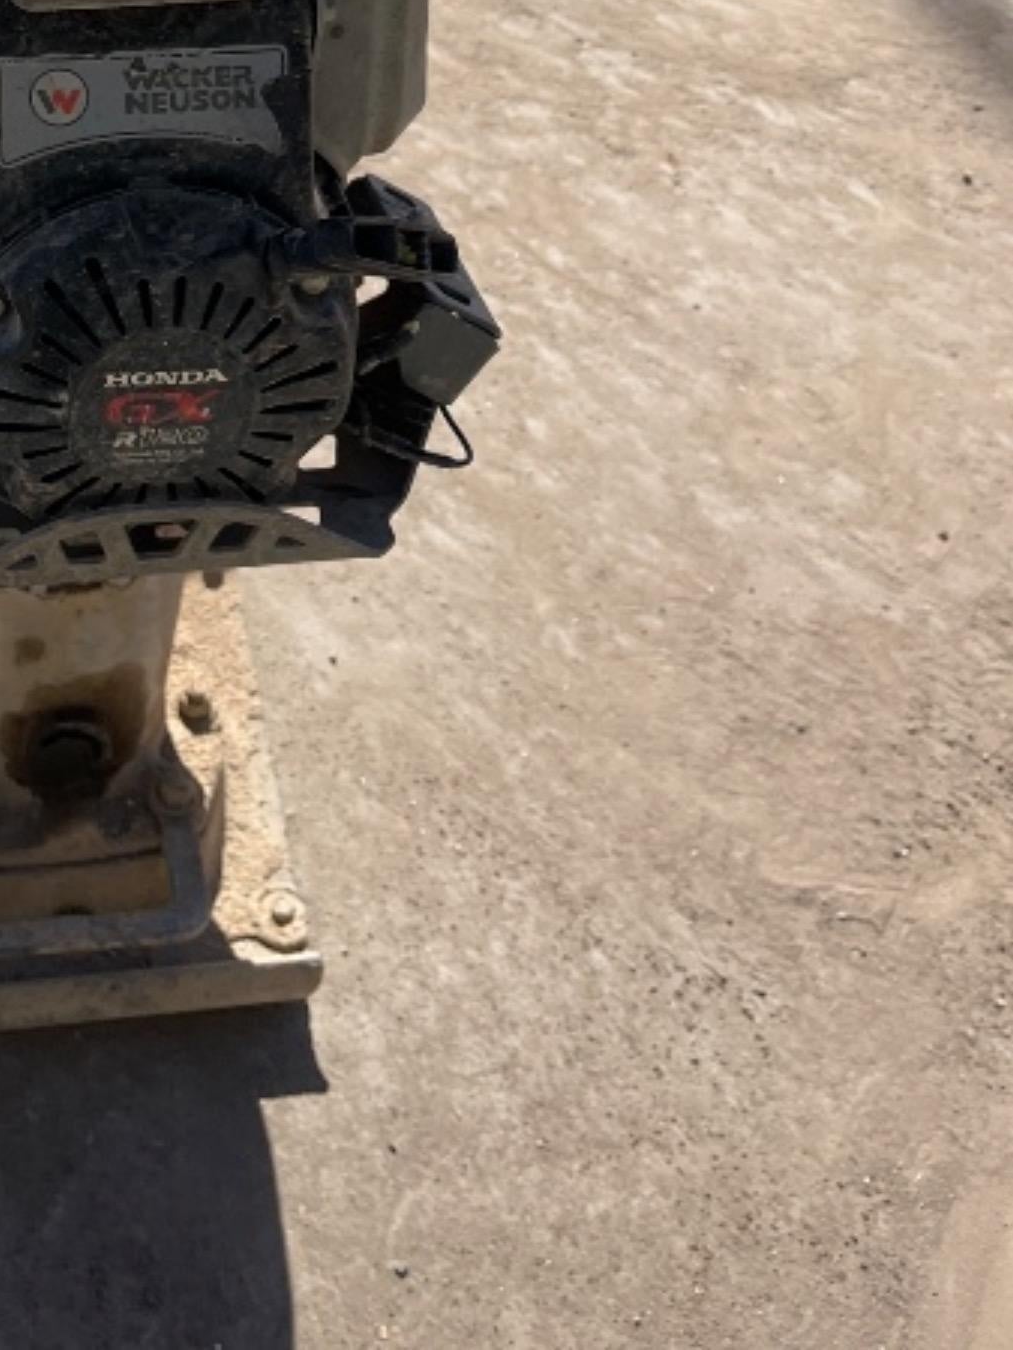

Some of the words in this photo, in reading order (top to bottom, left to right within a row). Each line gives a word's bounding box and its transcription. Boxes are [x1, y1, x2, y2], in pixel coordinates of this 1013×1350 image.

[123, 57, 256, 91] WACKER
[124, 86, 258, 115] NEUSON
[103, 368, 229, 388] HONDA
